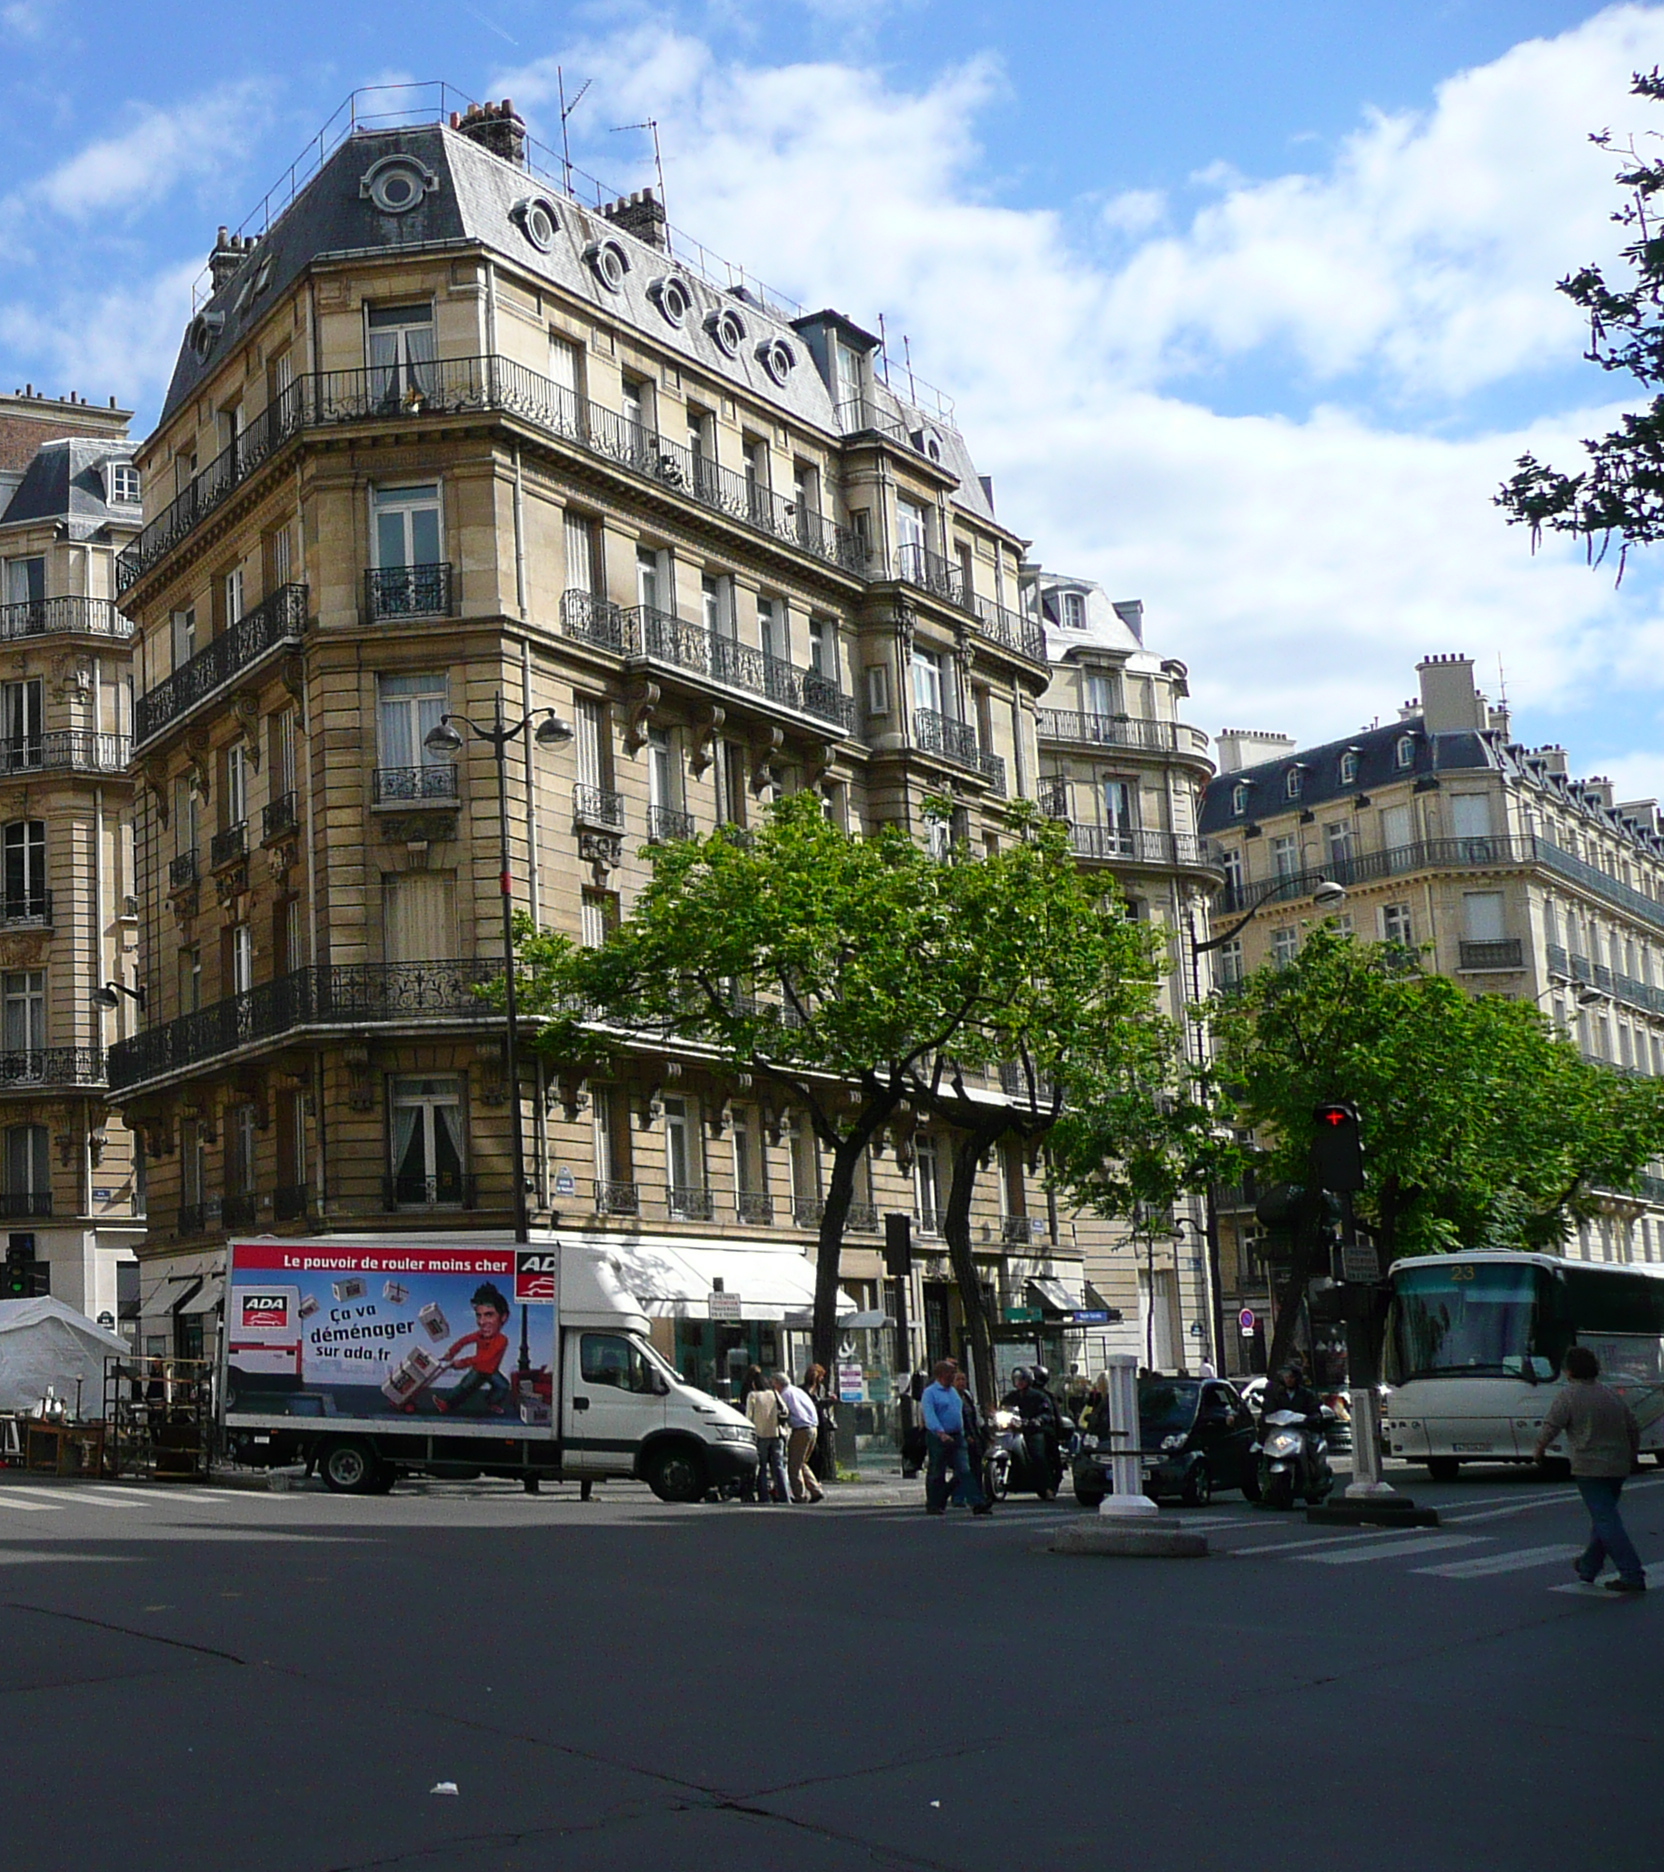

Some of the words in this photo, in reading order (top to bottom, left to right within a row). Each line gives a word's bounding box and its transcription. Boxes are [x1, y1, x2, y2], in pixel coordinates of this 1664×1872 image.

[284, 1254, 300, 1268] Le
[304, 1256, 358, 1270] pouvoir
[361, 1256, 378, 1269] de
[382, 1257, 425, 1270] rouler
[428, 1258, 471, 1271] moins
[475, 1259, 508, 1272] cher
[1450, 1265, 1475, 1281] 23
[245, 1298, 284, 1310] ADA
[330, 1308, 351, 1325] Ça
[356, 1304, 377, 1318] va
[311, 1320, 415, 1345] déménager
[316, 1345, 339, 1358] sur
[343, 1346, 392, 1361] ada.fr
